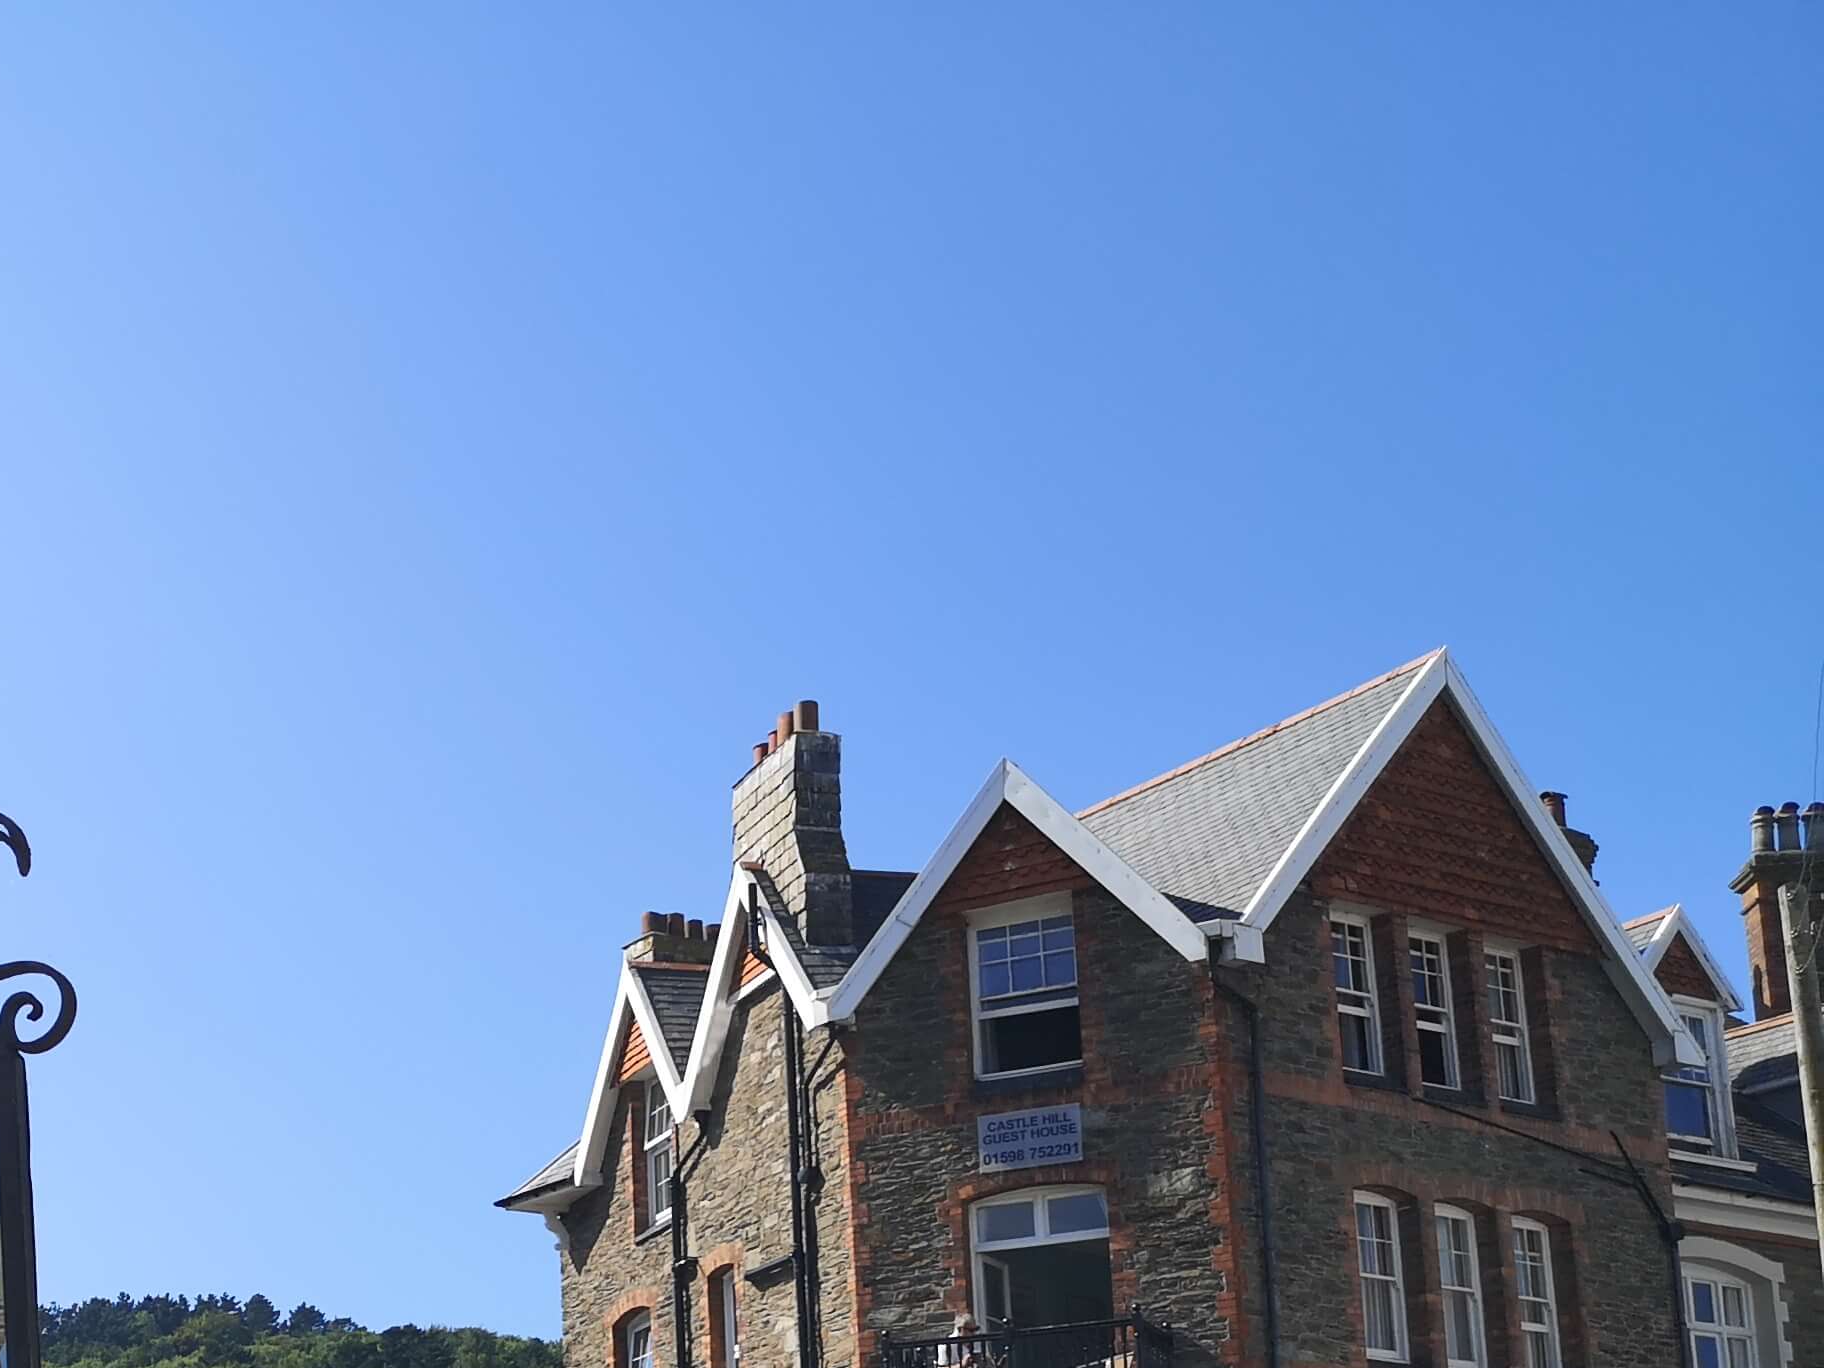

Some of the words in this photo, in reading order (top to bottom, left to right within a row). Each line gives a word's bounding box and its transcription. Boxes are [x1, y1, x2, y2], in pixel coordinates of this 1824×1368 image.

[987, 1116, 1039, 1133] CASTLE
[1042, 1112, 1072, 1126] HILL
[982, 1131, 1028, 1146] GUEST
[1030, 1123, 1078, 1139] HOUSE
[983, 1150, 1025, 1166] 01598
[1029, 1142, 1080, 1160] 752291
